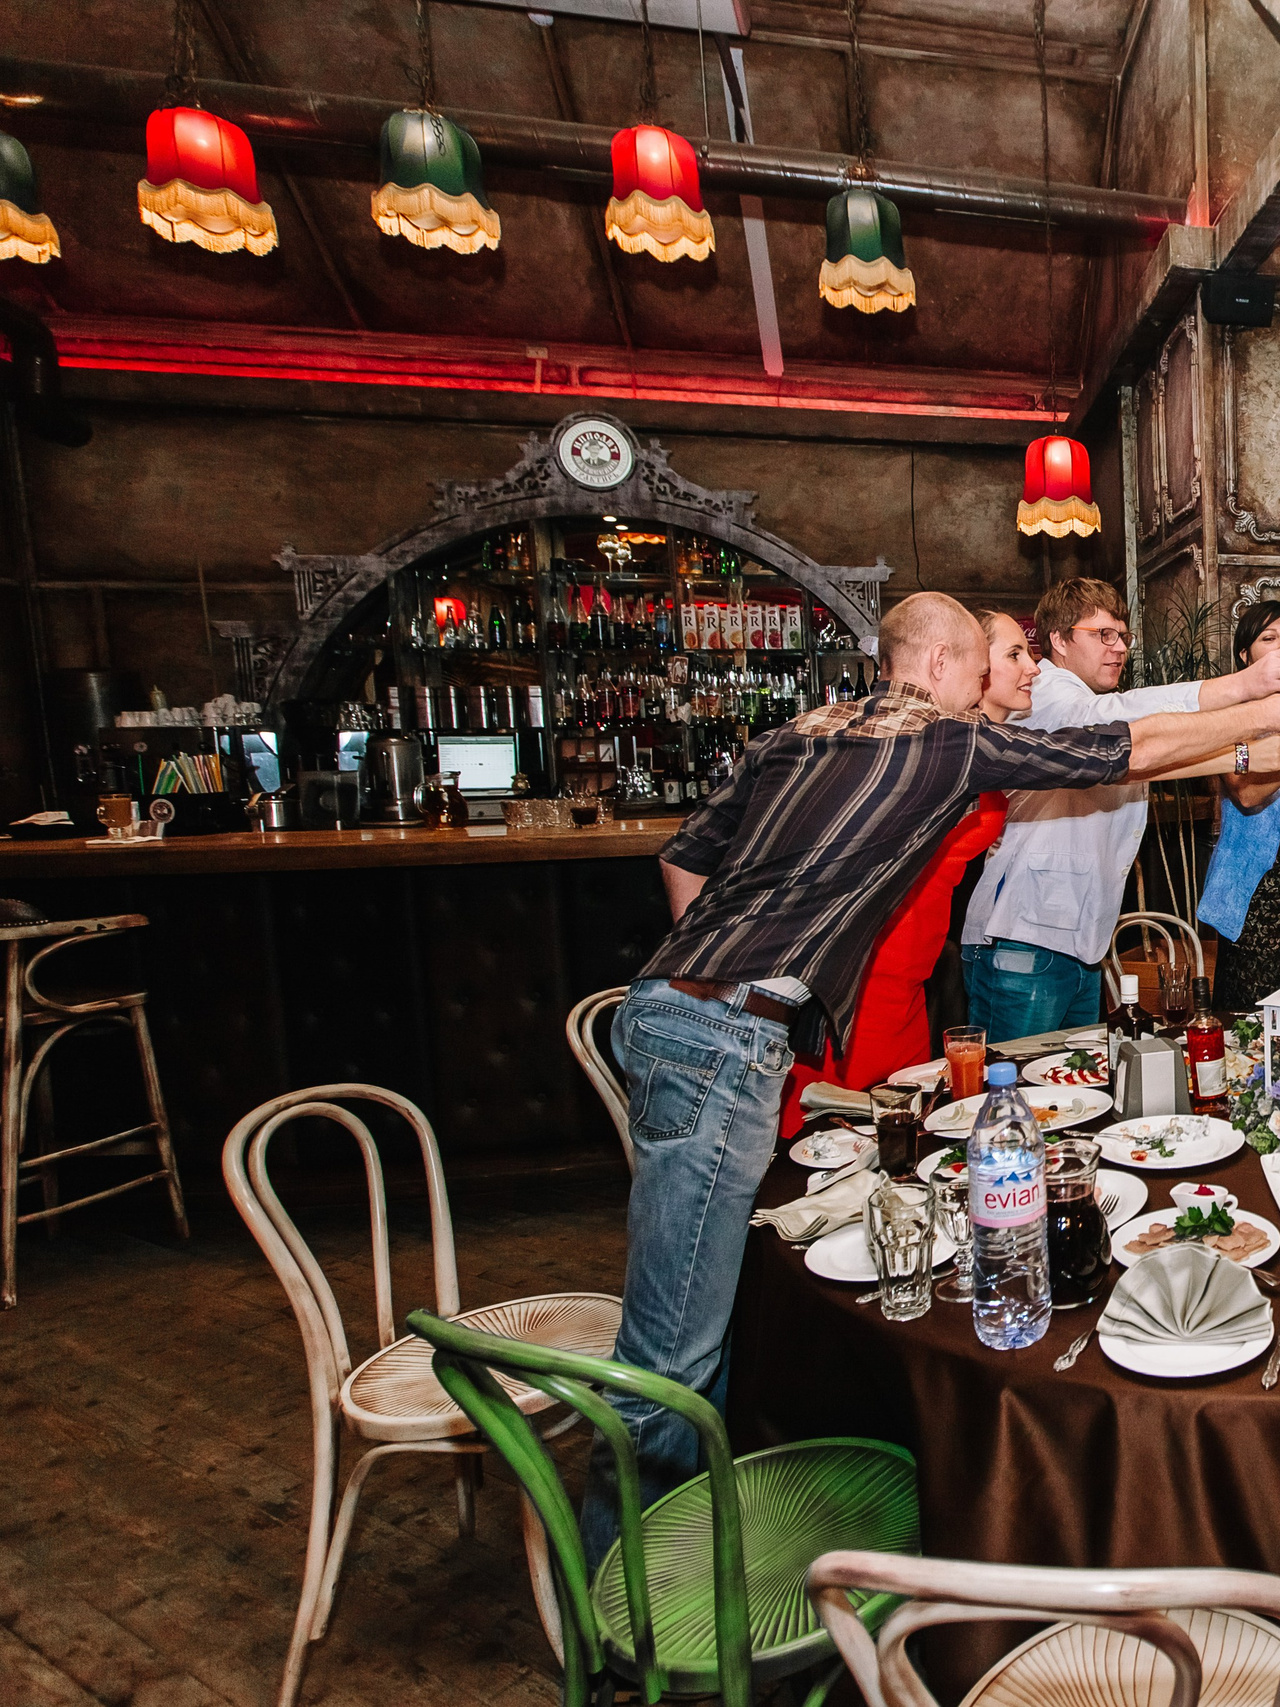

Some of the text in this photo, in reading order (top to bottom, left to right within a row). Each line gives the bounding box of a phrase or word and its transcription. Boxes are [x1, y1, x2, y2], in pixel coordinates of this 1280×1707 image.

[684, 616, 693, 627] R
[706, 616, 717, 629] R
[730, 616, 739, 627] R
[750, 616, 760, 627] R
[768, 616, 778, 627] R
[789, 616, 798, 627] R
[984, 1184, 1040, 1210] evian
